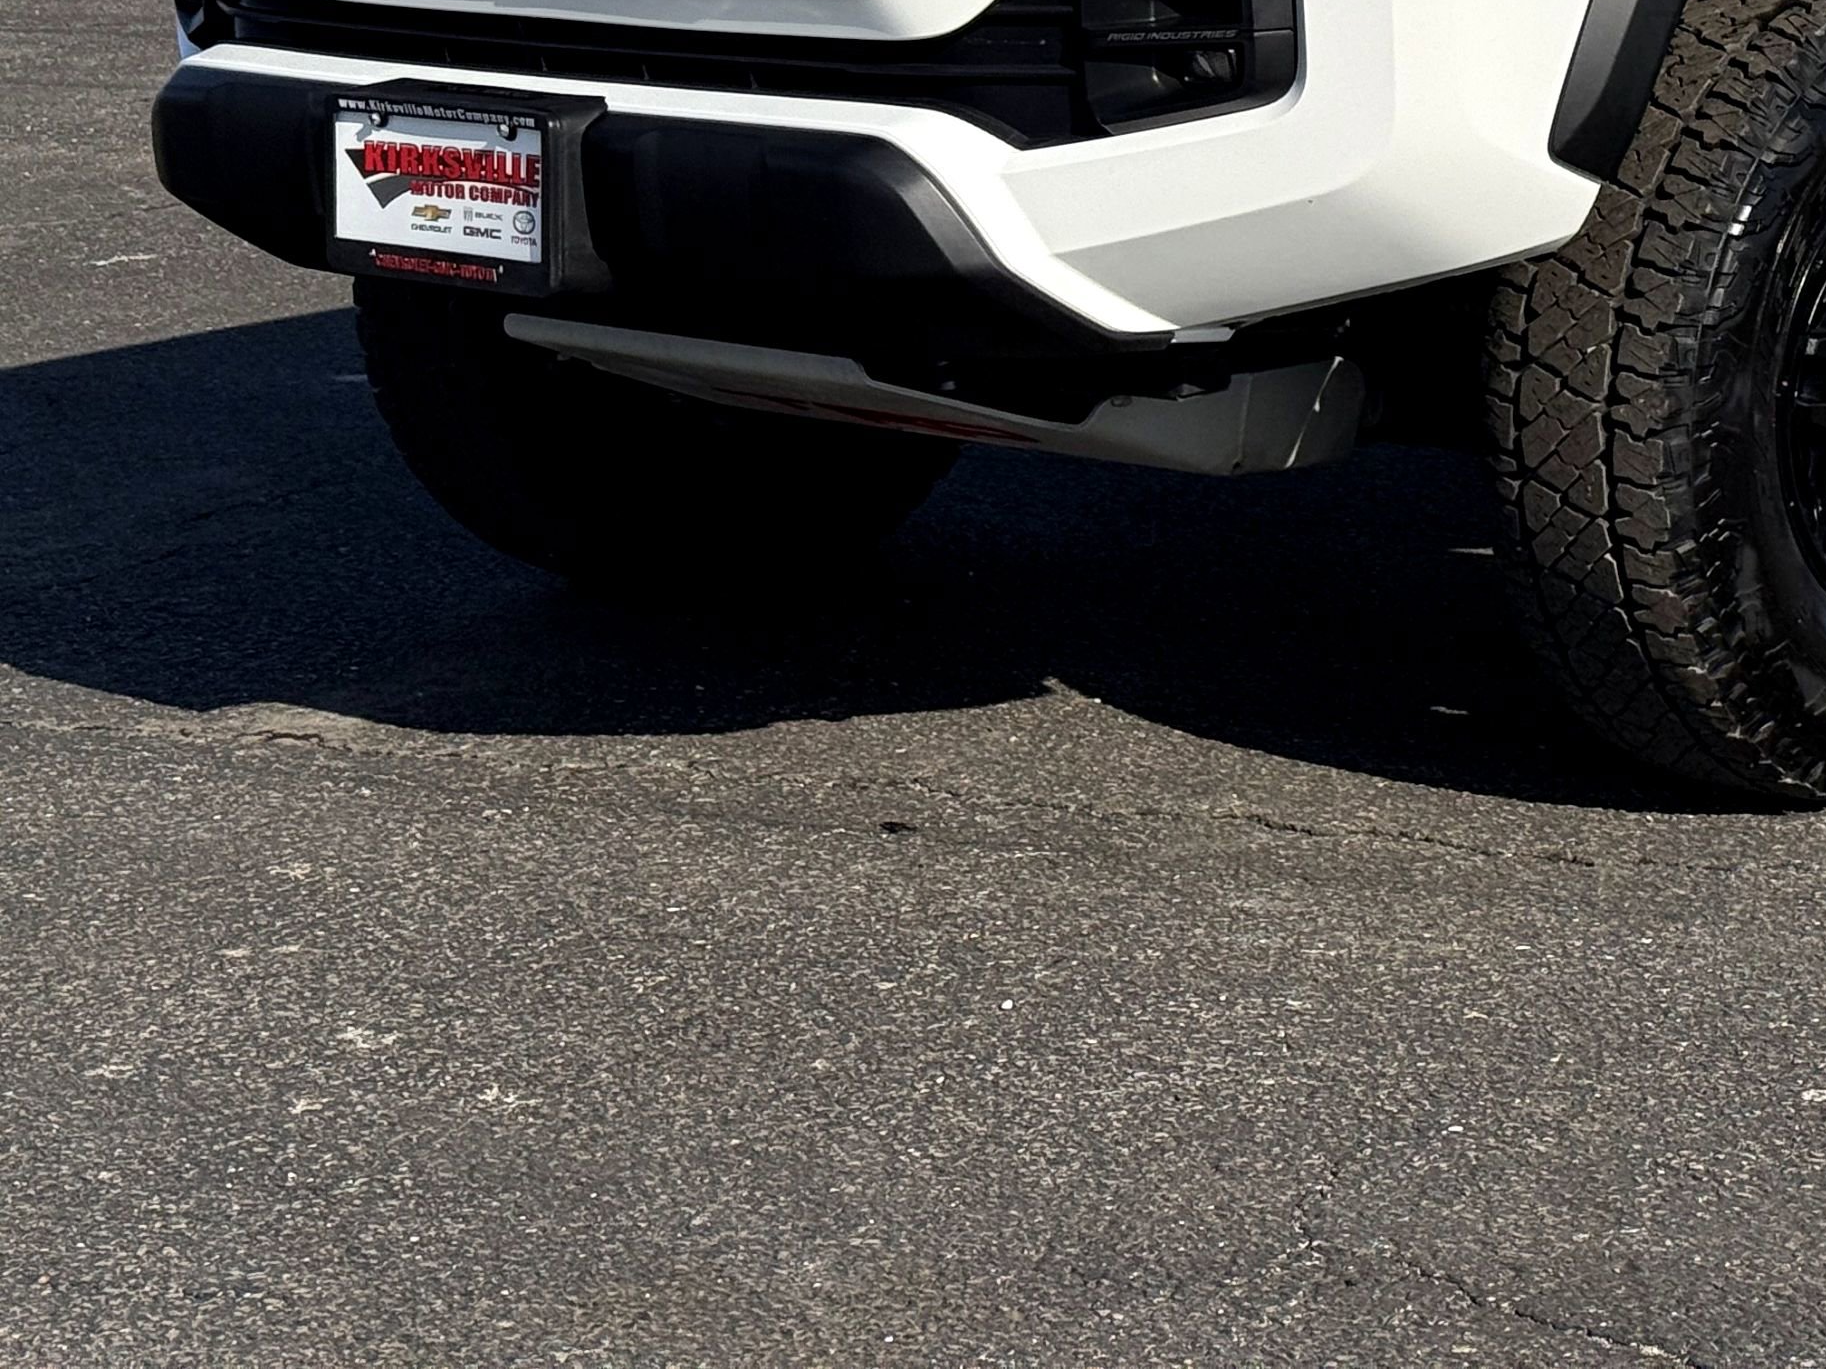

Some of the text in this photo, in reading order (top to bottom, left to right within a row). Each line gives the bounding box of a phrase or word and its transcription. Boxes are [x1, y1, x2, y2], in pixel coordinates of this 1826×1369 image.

[1106, 29, 1240, 42] RIGID INDUSTRIES
[363, 140, 542, 188] KIRKSVILLE
[409, 180, 540, 209] MOTOR COMPANY
[462, 225, 502, 240] GMC
[510, 235, 538, 248] TOYOTA
